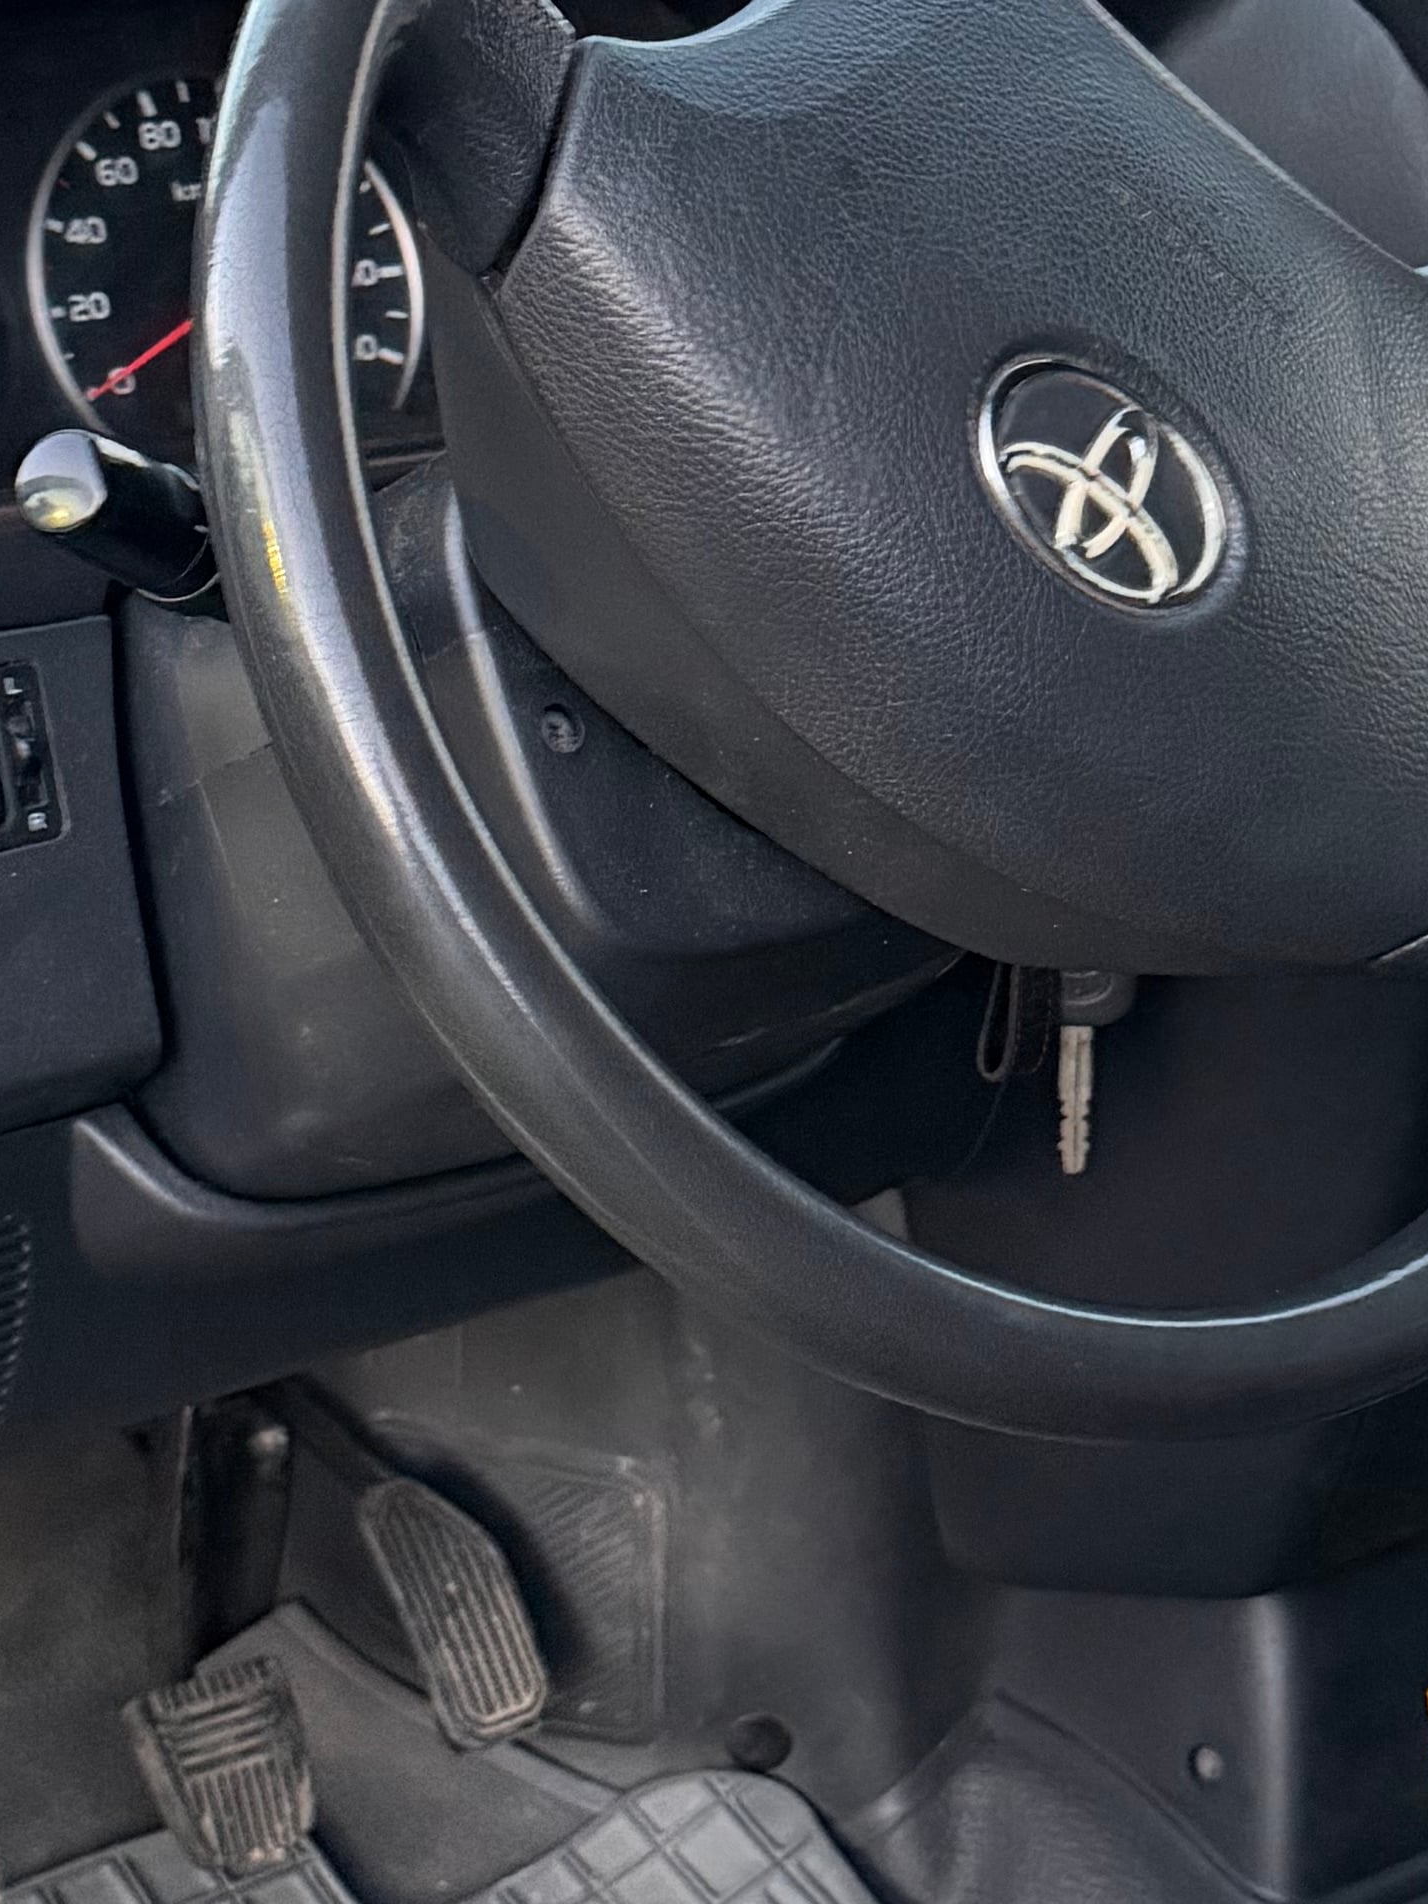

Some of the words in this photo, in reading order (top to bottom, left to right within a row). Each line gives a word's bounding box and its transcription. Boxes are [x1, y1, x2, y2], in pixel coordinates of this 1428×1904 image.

[138, 119, 182, 150] 80
[95, 156, 139, 186] 60
[65, 216, 108, 244] 40
[68, 291, 111, 322] 20
[107, 367, 136, 395] 0
[3, 677, 23, 695] L
